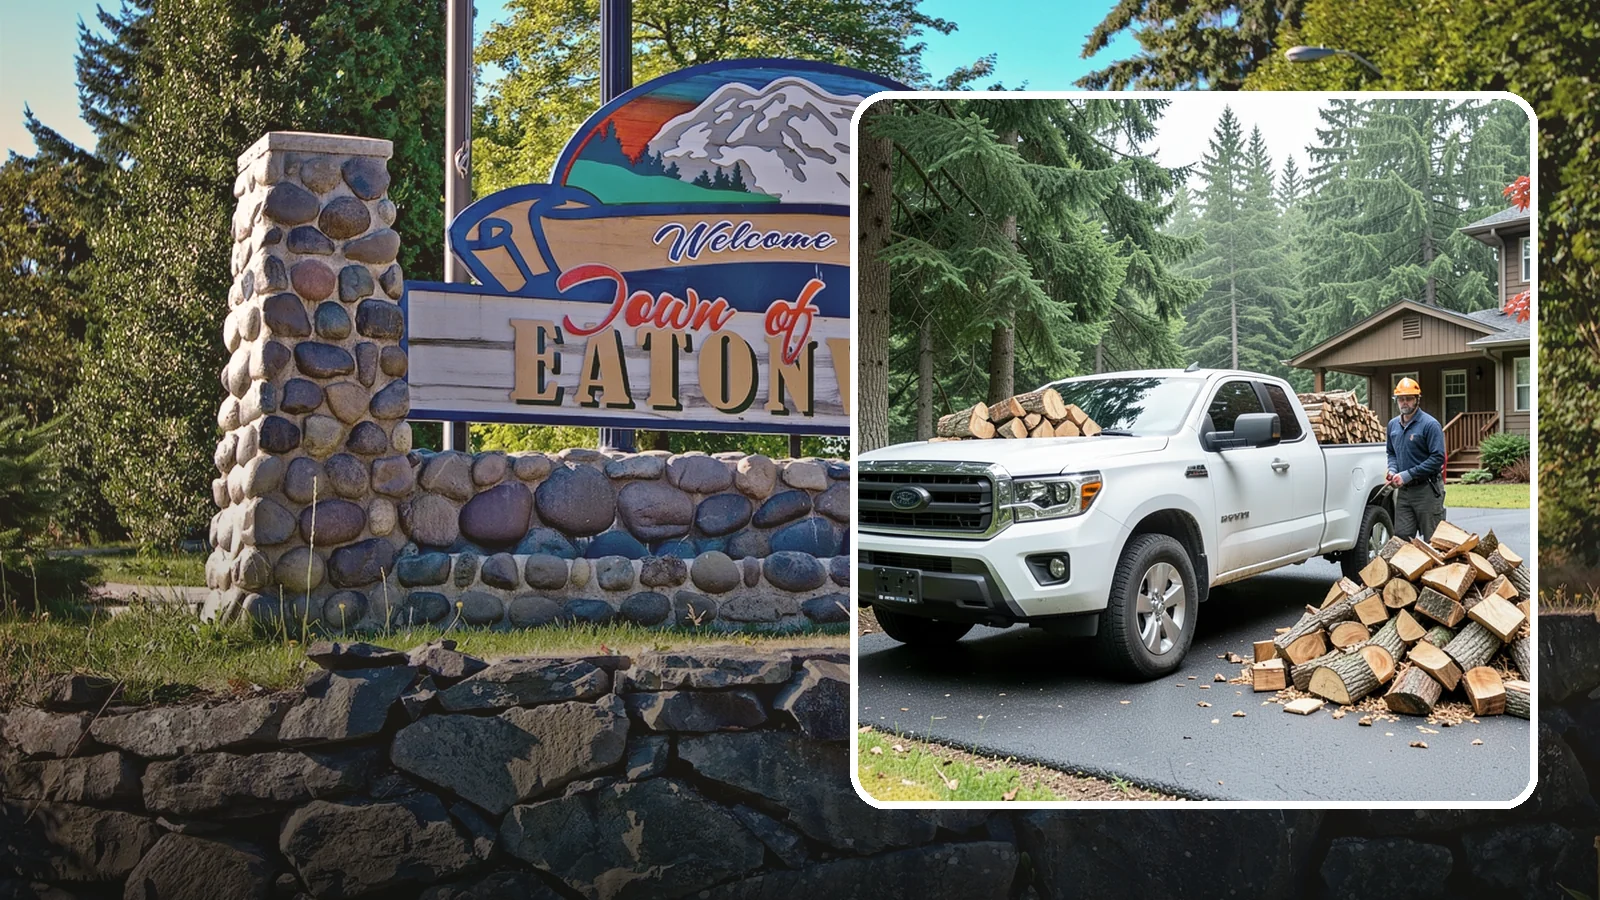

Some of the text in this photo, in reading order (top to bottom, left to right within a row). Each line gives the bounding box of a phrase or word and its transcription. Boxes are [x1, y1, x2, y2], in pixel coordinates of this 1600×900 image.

[653, 220, 837, 263] Welcome
[556, 263, 827, 365] Town of
